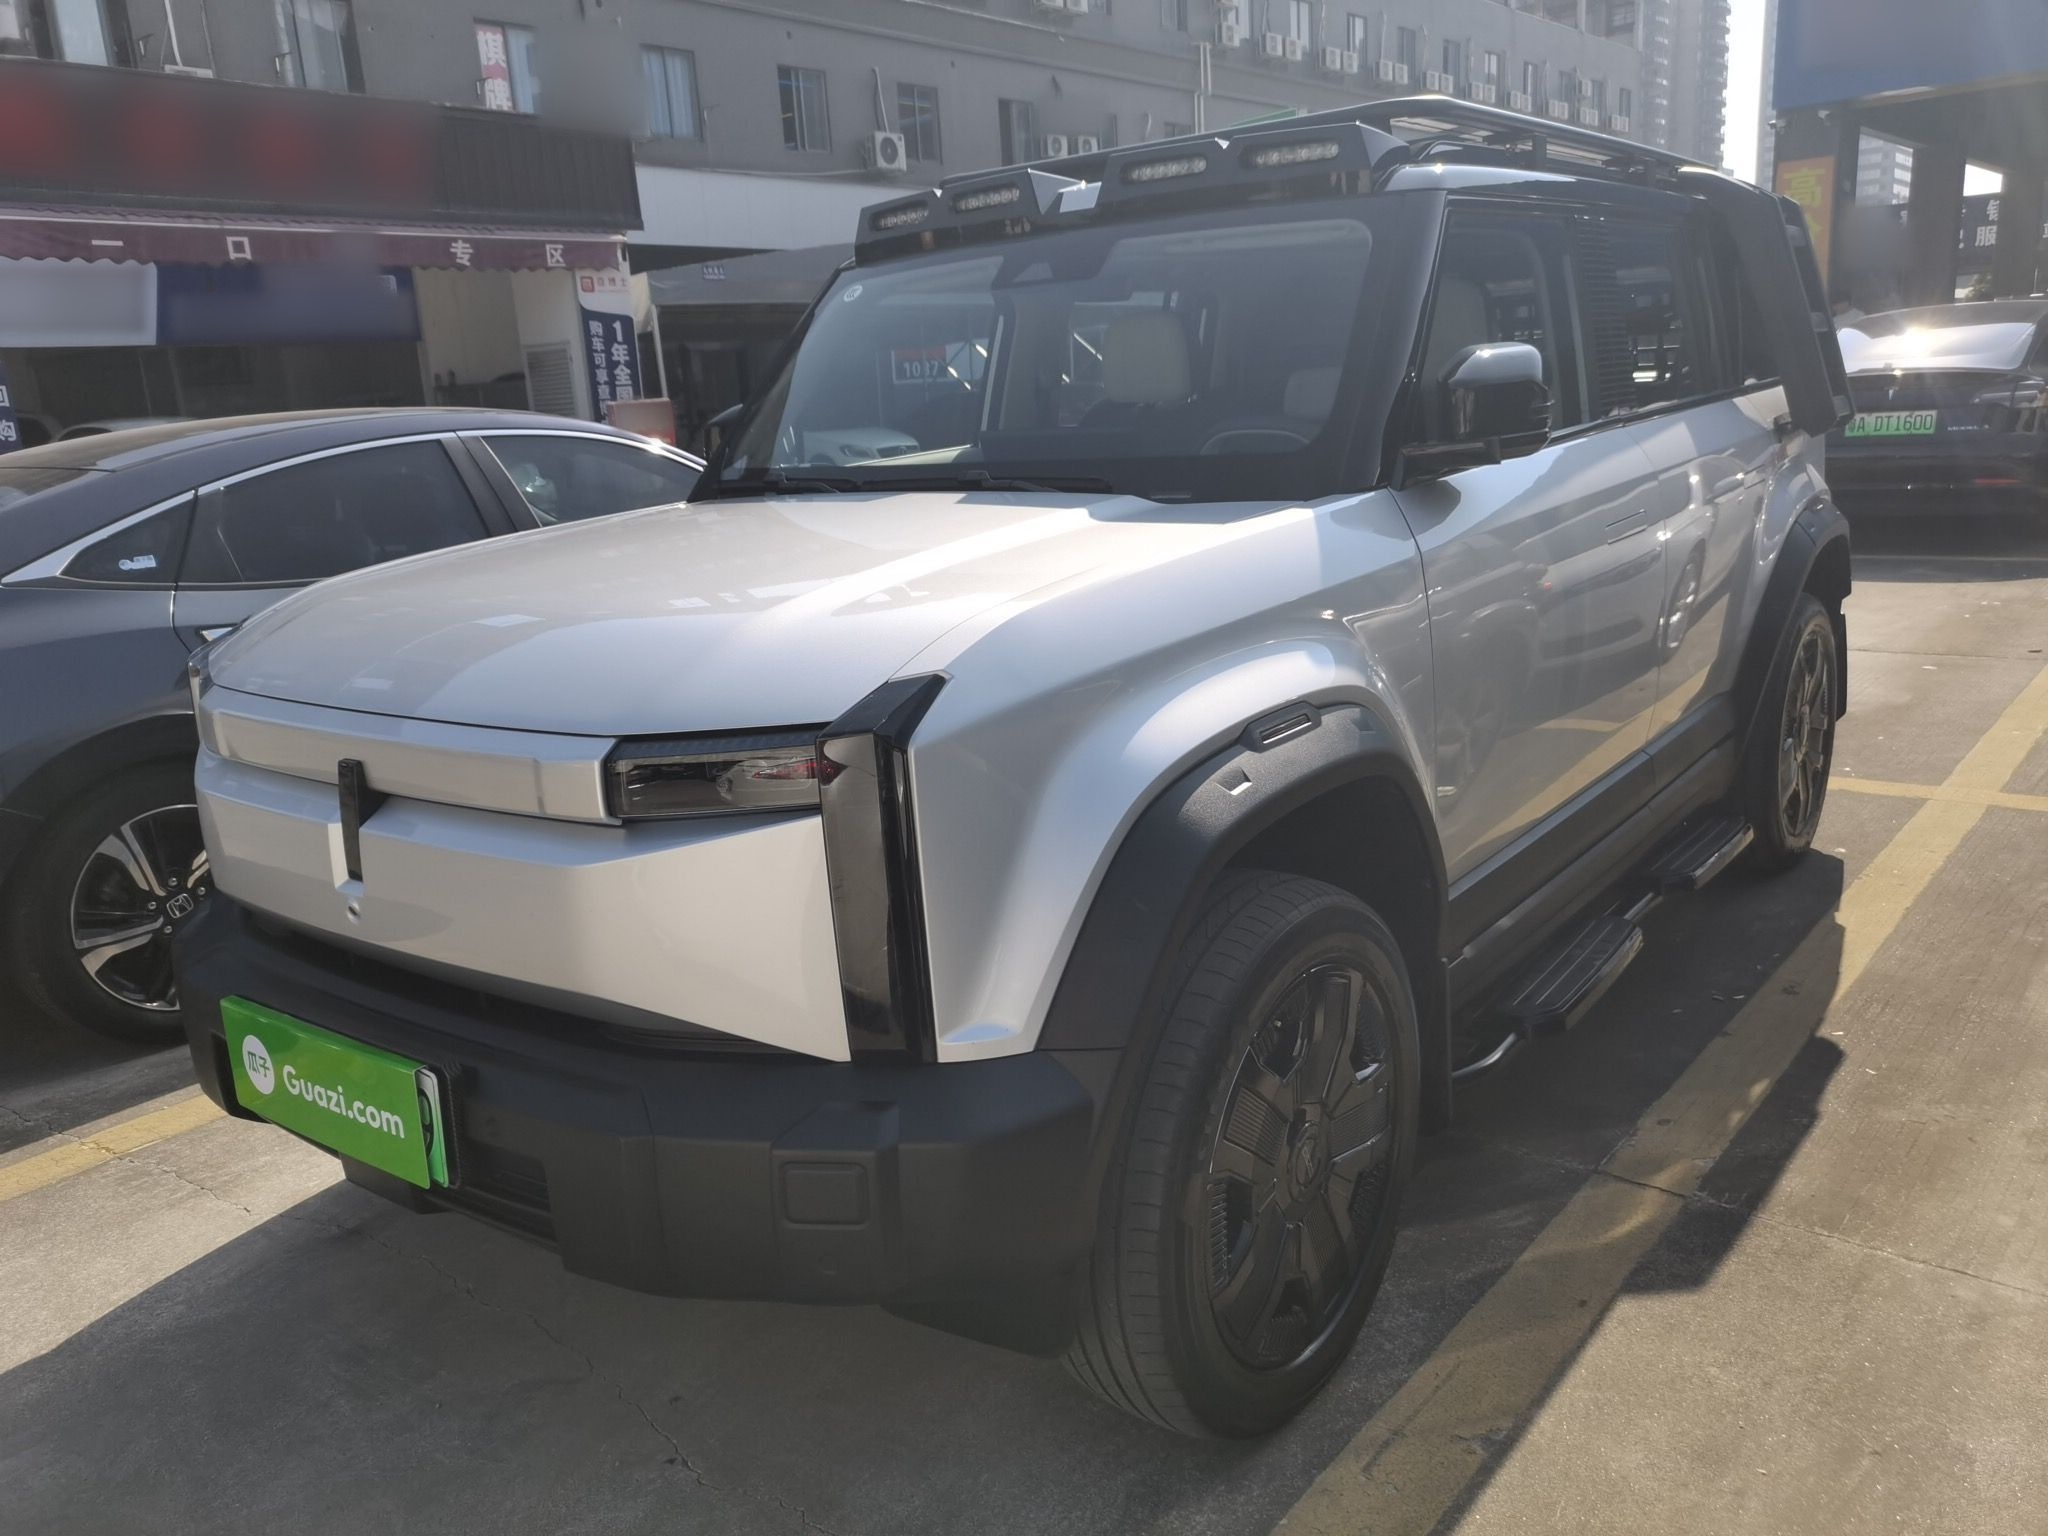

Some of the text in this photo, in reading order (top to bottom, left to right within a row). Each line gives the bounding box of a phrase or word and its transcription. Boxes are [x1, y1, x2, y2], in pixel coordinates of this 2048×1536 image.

[1874, 414, 1934, 433] DT1600
[247, 1051, 271, 1078] 瓜子
[282, 1064, 406, 1139] Guazi.com
